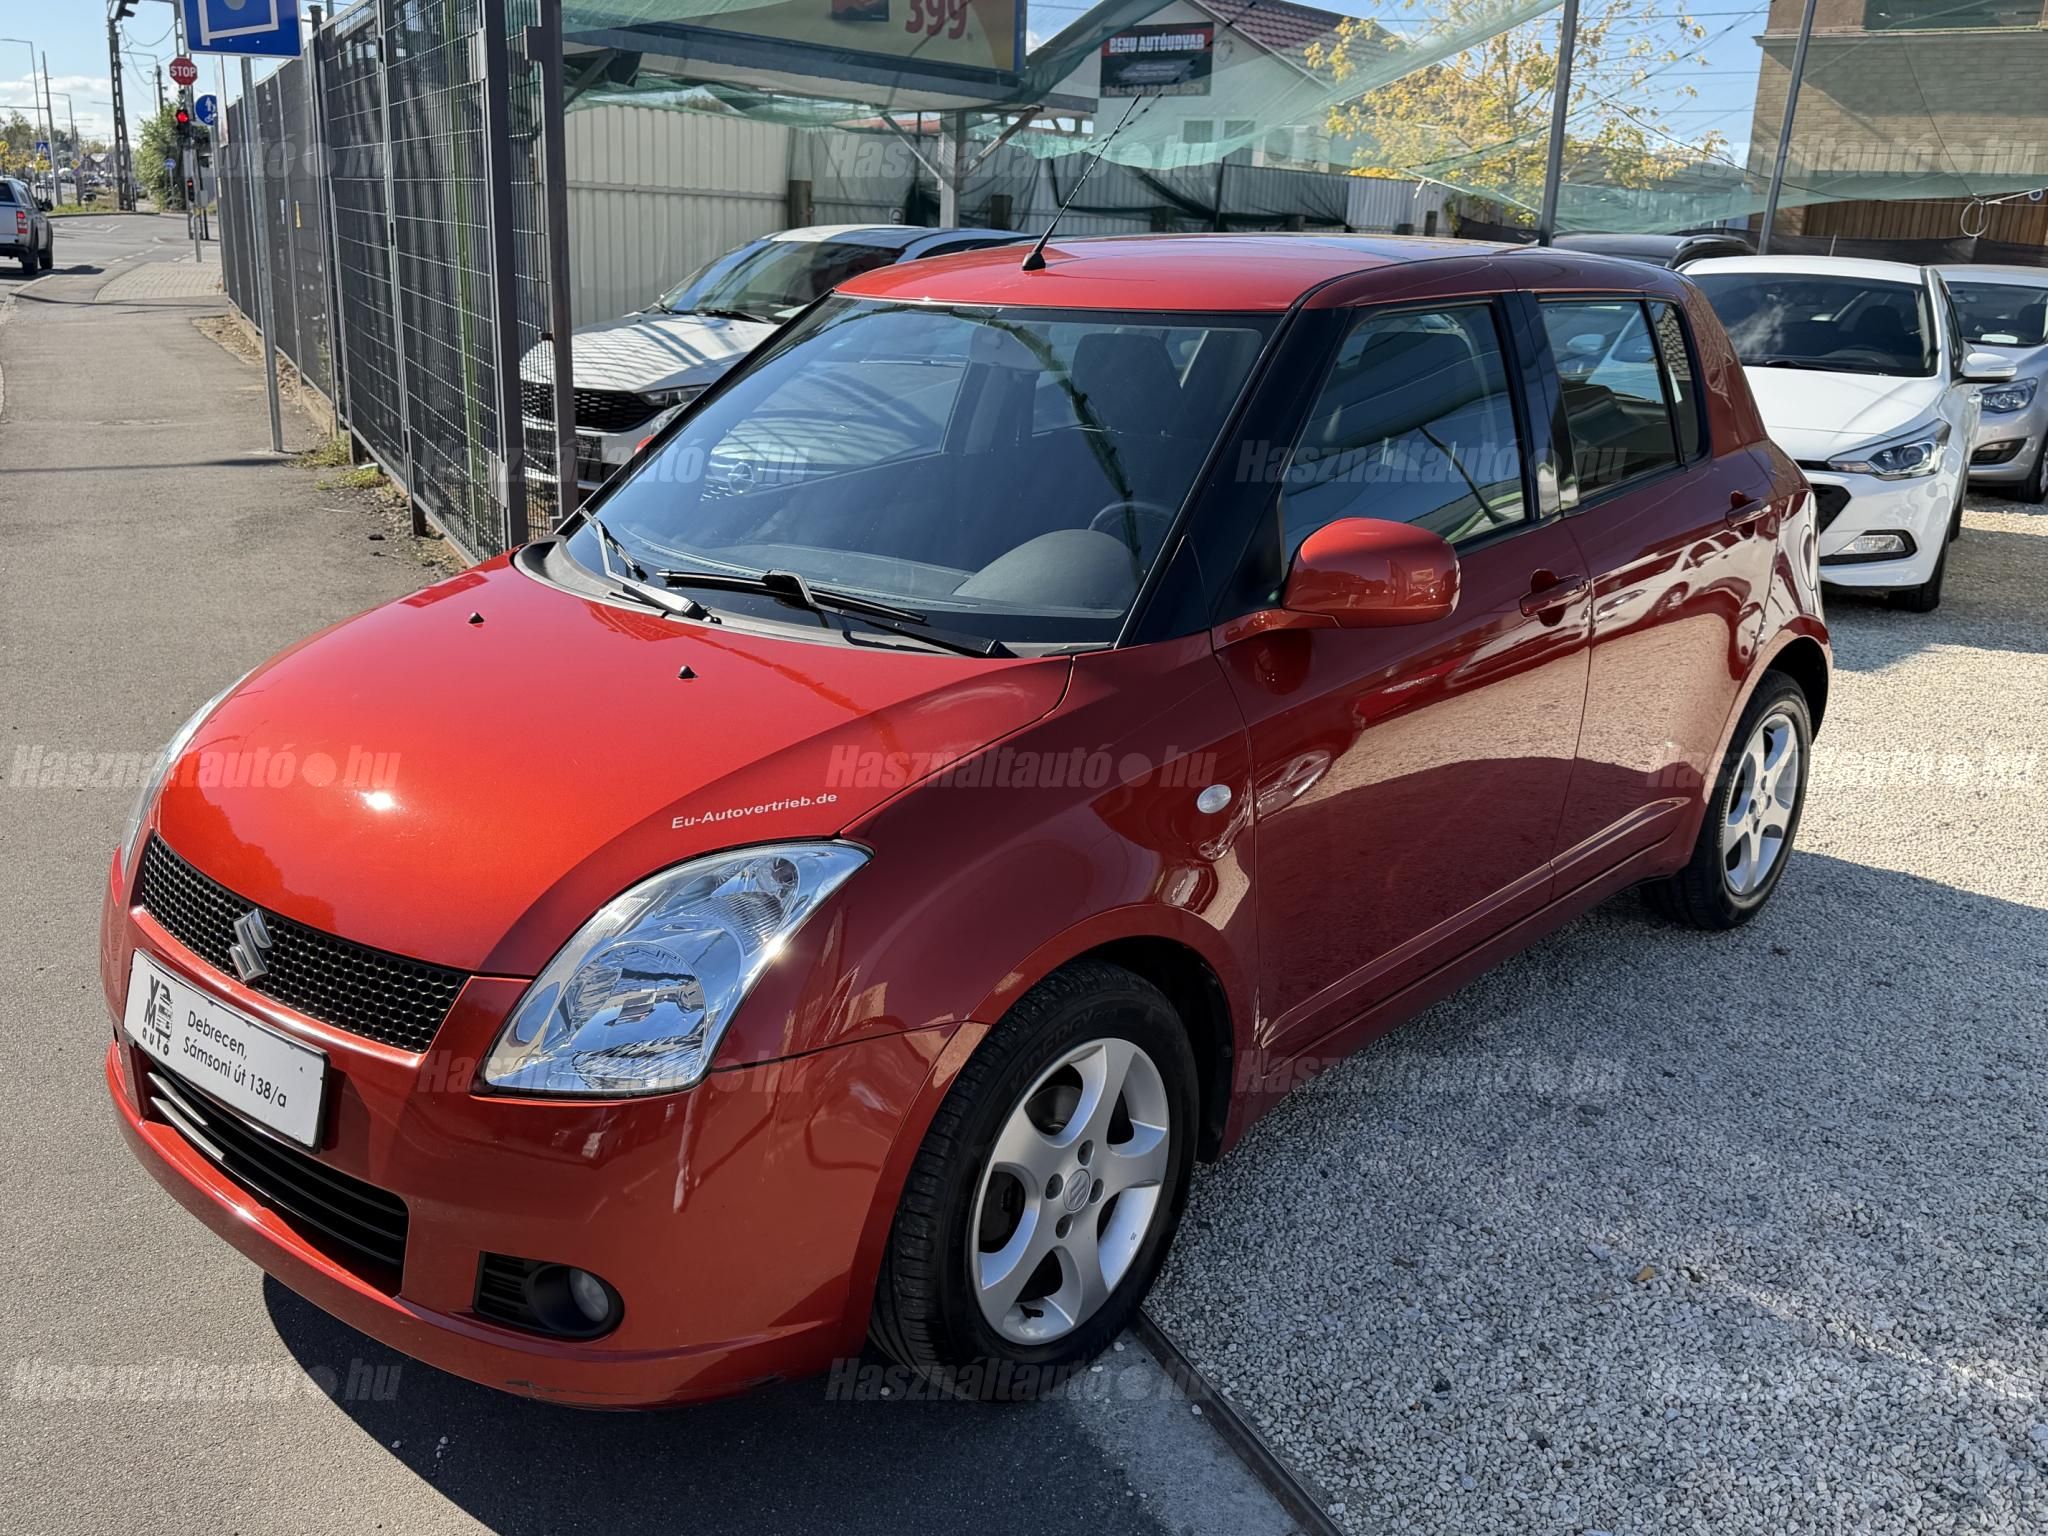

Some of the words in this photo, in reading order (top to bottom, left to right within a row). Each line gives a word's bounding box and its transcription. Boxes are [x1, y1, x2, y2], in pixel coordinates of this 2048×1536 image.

[170, 65, 197, 78] STOP
[671, 793, 838, 829] Eu-Autovertrieb.de
[187, 1010, 248, 1060] Debrecen,
[183, 1036, 232, 1078] Sámsoni
[233, 1064, 247, 1086] út
[249, 1074, 288, 1108] 138/a
